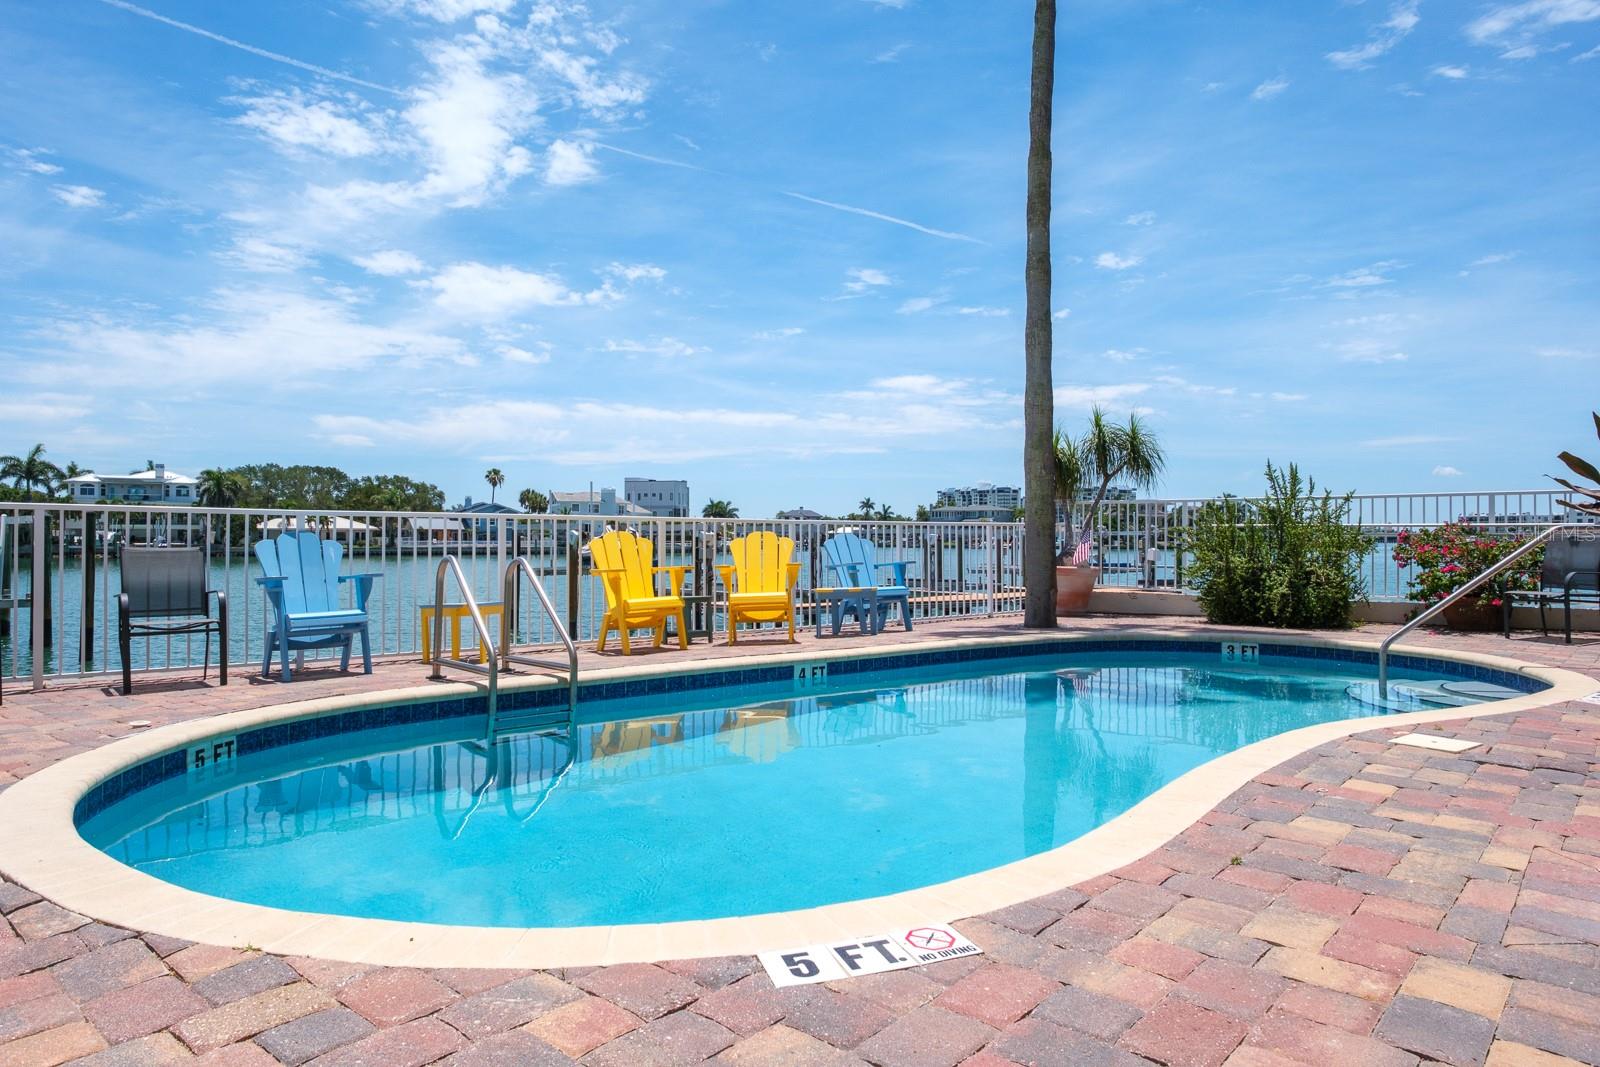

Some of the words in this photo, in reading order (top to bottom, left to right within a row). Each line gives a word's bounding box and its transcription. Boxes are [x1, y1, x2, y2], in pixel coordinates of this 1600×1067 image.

[1241, 645, 1257, 656] FT
[799, 667, 806, 679] 4
[812, 666, 826, 678] FT
[195, 748, 206, 768] 5
[213, 740, 235, 763] FT
[781, 951, 820, 978] 5
[833, 939, 908, 971] FT.
[919, 954, 937, 962] NO
[937, 945, 977, 956] DIVING
